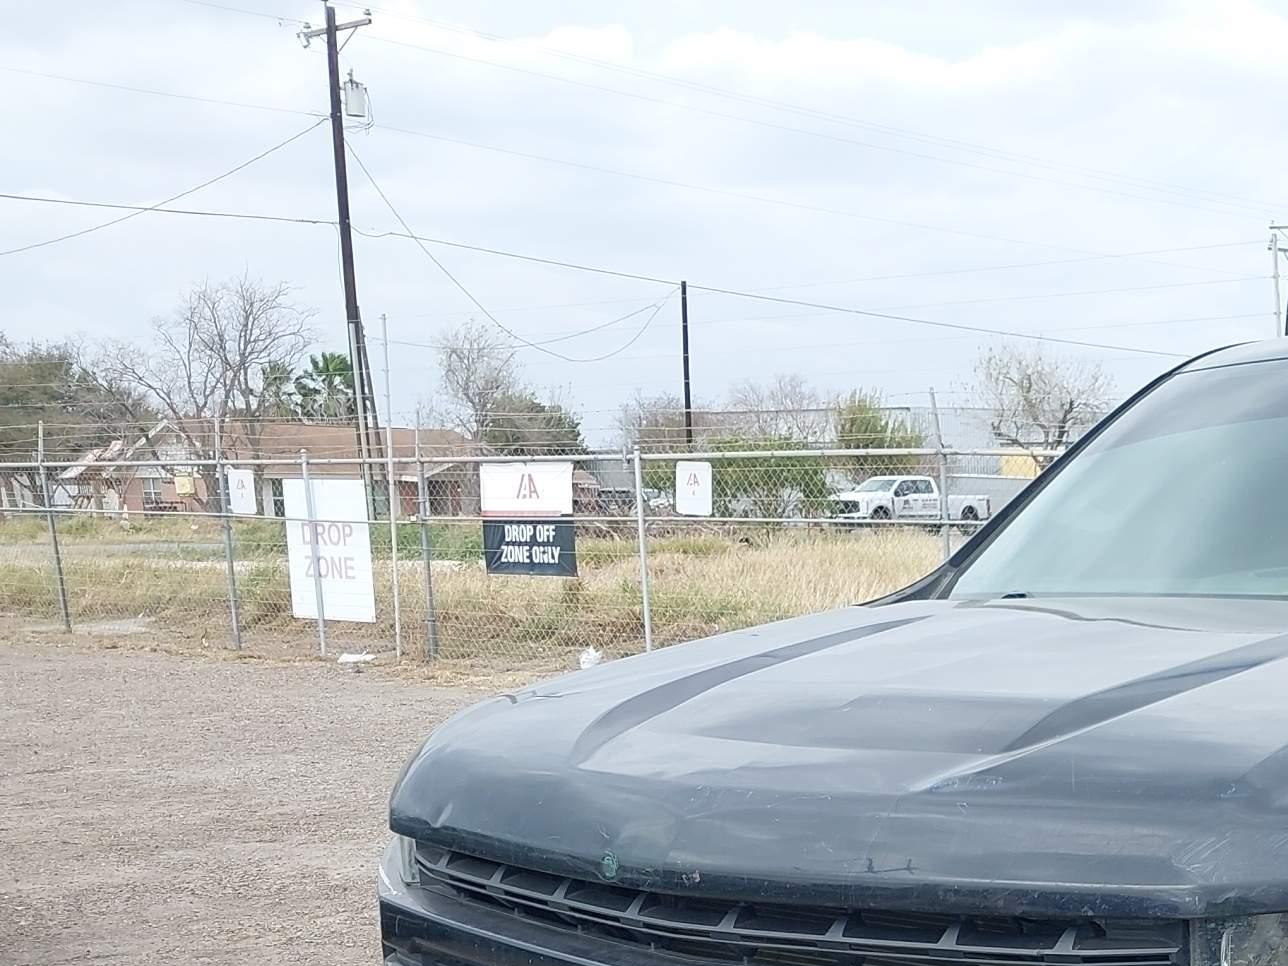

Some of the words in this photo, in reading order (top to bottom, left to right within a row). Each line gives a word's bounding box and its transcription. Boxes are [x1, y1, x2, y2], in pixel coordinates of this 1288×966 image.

[301, 522, 353, 547] DROP
[504, 524, 534, 543] DROP
[535, 525, 556, 543] OFF
[500, 545, 531, 563] ZONE
[531, 546, 561, 564] ONLY
[304, 555, 356, 580] ZONE
